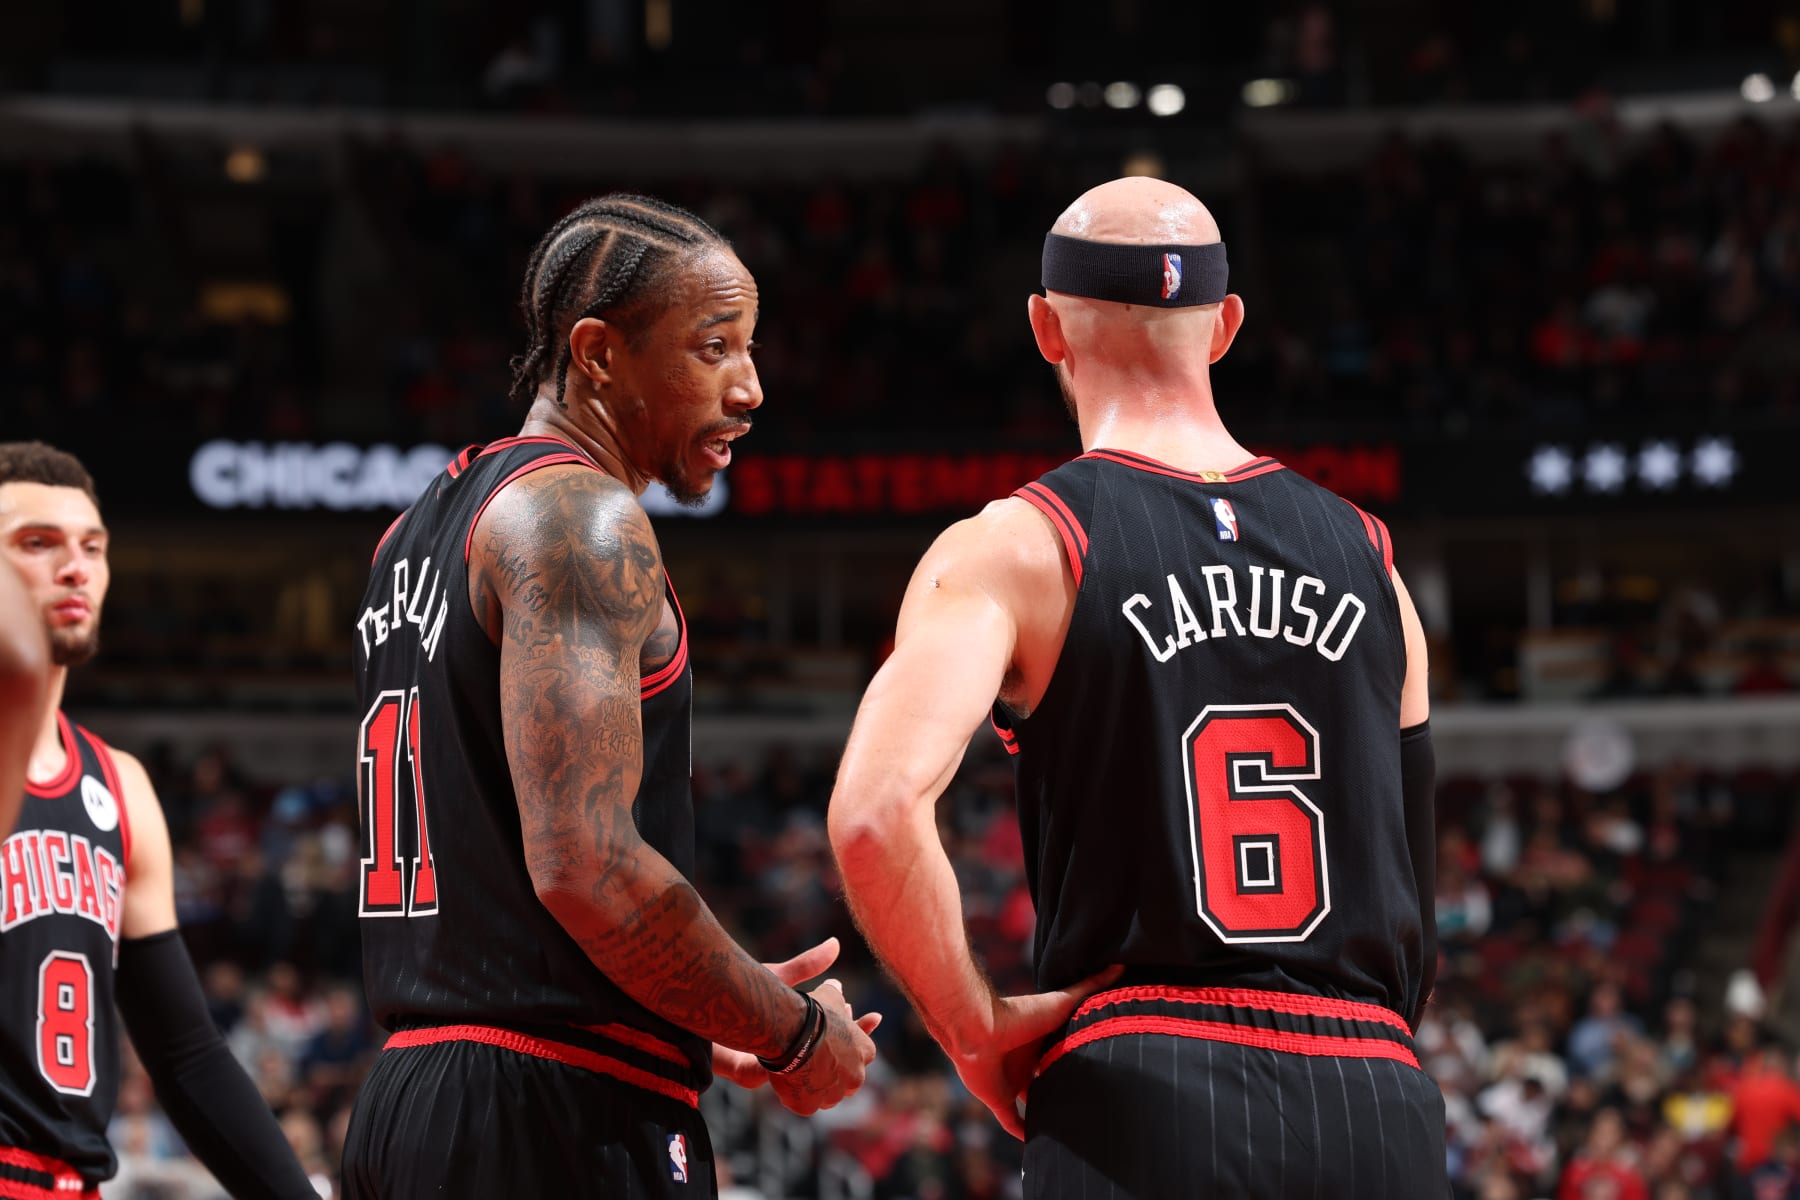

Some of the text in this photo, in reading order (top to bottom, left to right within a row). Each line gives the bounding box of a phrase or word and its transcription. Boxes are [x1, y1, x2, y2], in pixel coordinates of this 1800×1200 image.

[189, 440, 447, 510] CHICAG
[735, 452, 1073, 515] STATEME
[1122, 565, 1366, 662] CARUSO
[358, 686, 439, 918] 11
[1181, 702, 1331, 944] 6
[0, 829, 126, 969] HICAG
[36, 949, 97, 1097] 8
